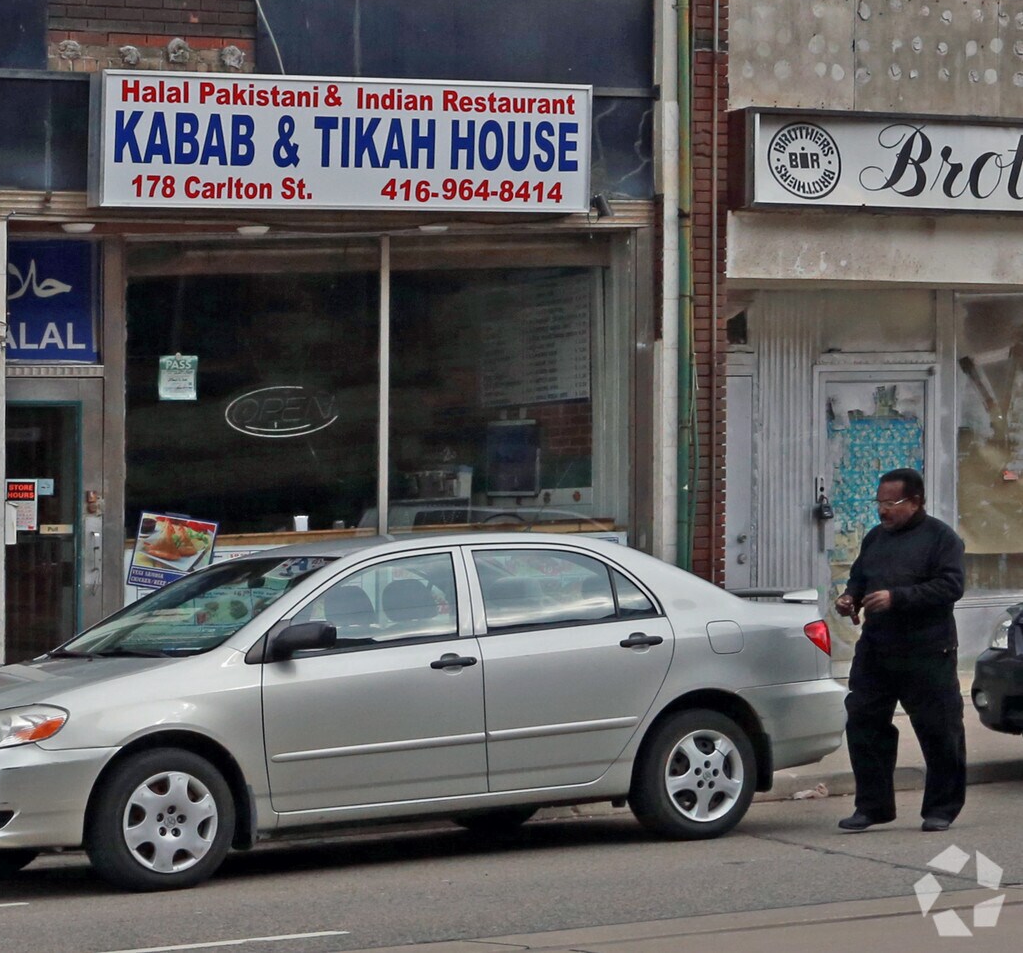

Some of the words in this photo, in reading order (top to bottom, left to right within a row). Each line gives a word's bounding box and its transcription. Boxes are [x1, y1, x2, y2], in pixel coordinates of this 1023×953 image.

[122, 80, 190, 104] Halal
[199, 82, 319, 107] Pakistani
[324, 85, 343, 107] &
[357, 88, 433, 111] Indian
[443, 90, 575, 115] Restaurant
[114, 110, 255, 166] KABAB
[272, 115, 300, 168] &
[314, 116, 436, 169] TIKAH
[451, 119, 578, 173] HOUSE
[774, 126, 835, 157] BROTHERS
[133, 174, 176, 199] 178
[184, 176, 273, 200] Carlton
[281, 177, 312, 200] St.
[381, 178, 563, 203] 416-964-8414
[774, 164, 836, 195] BROTHERS
[165, 359, 193, 369] PASS
